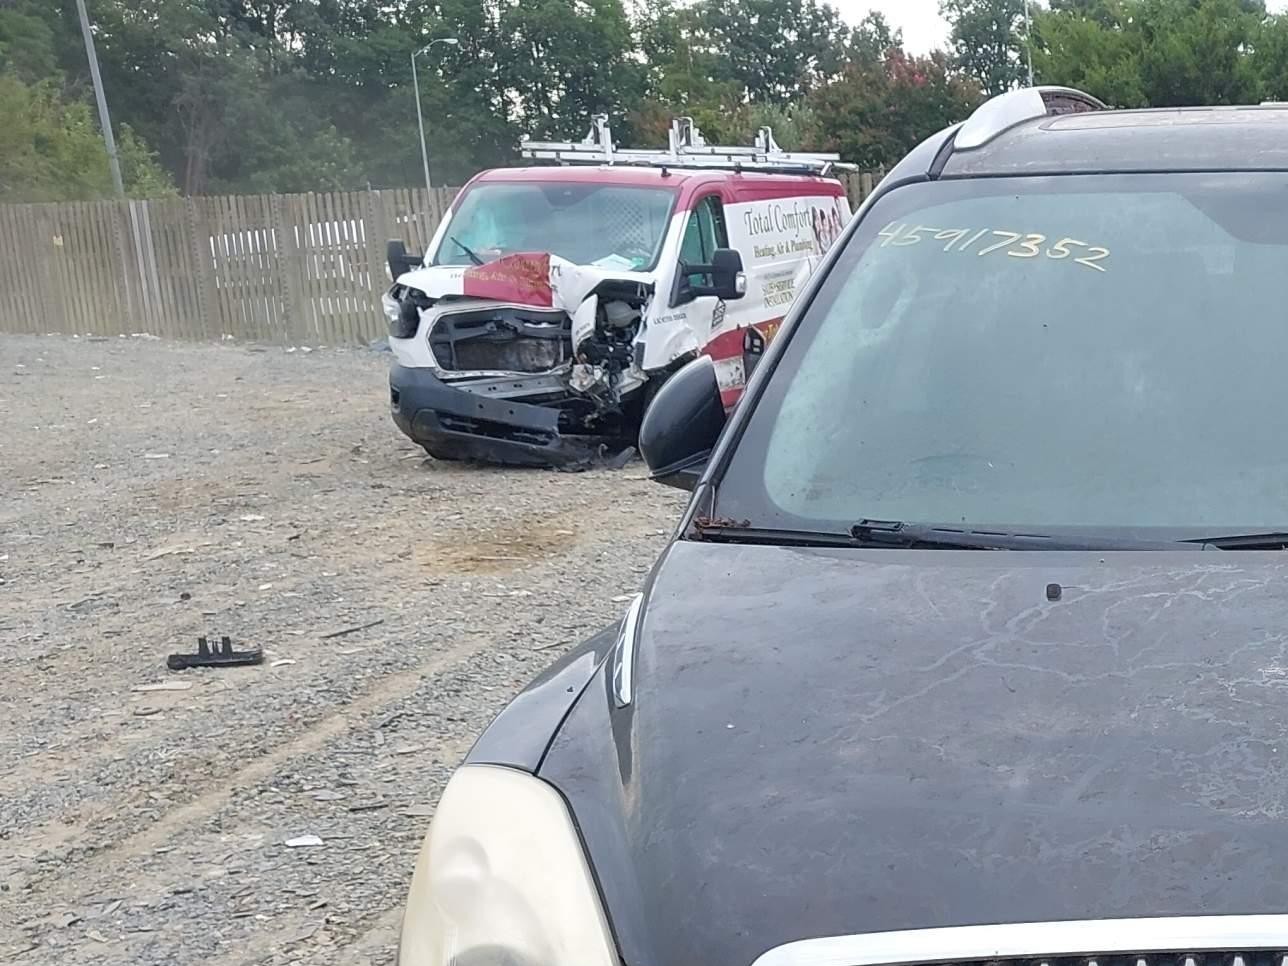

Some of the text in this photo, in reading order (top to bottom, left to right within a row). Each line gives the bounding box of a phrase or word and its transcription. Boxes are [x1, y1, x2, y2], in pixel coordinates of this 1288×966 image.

[744, 202, 812, 238] Total Comfort
[878, 221, 1111, 272] 45917352
